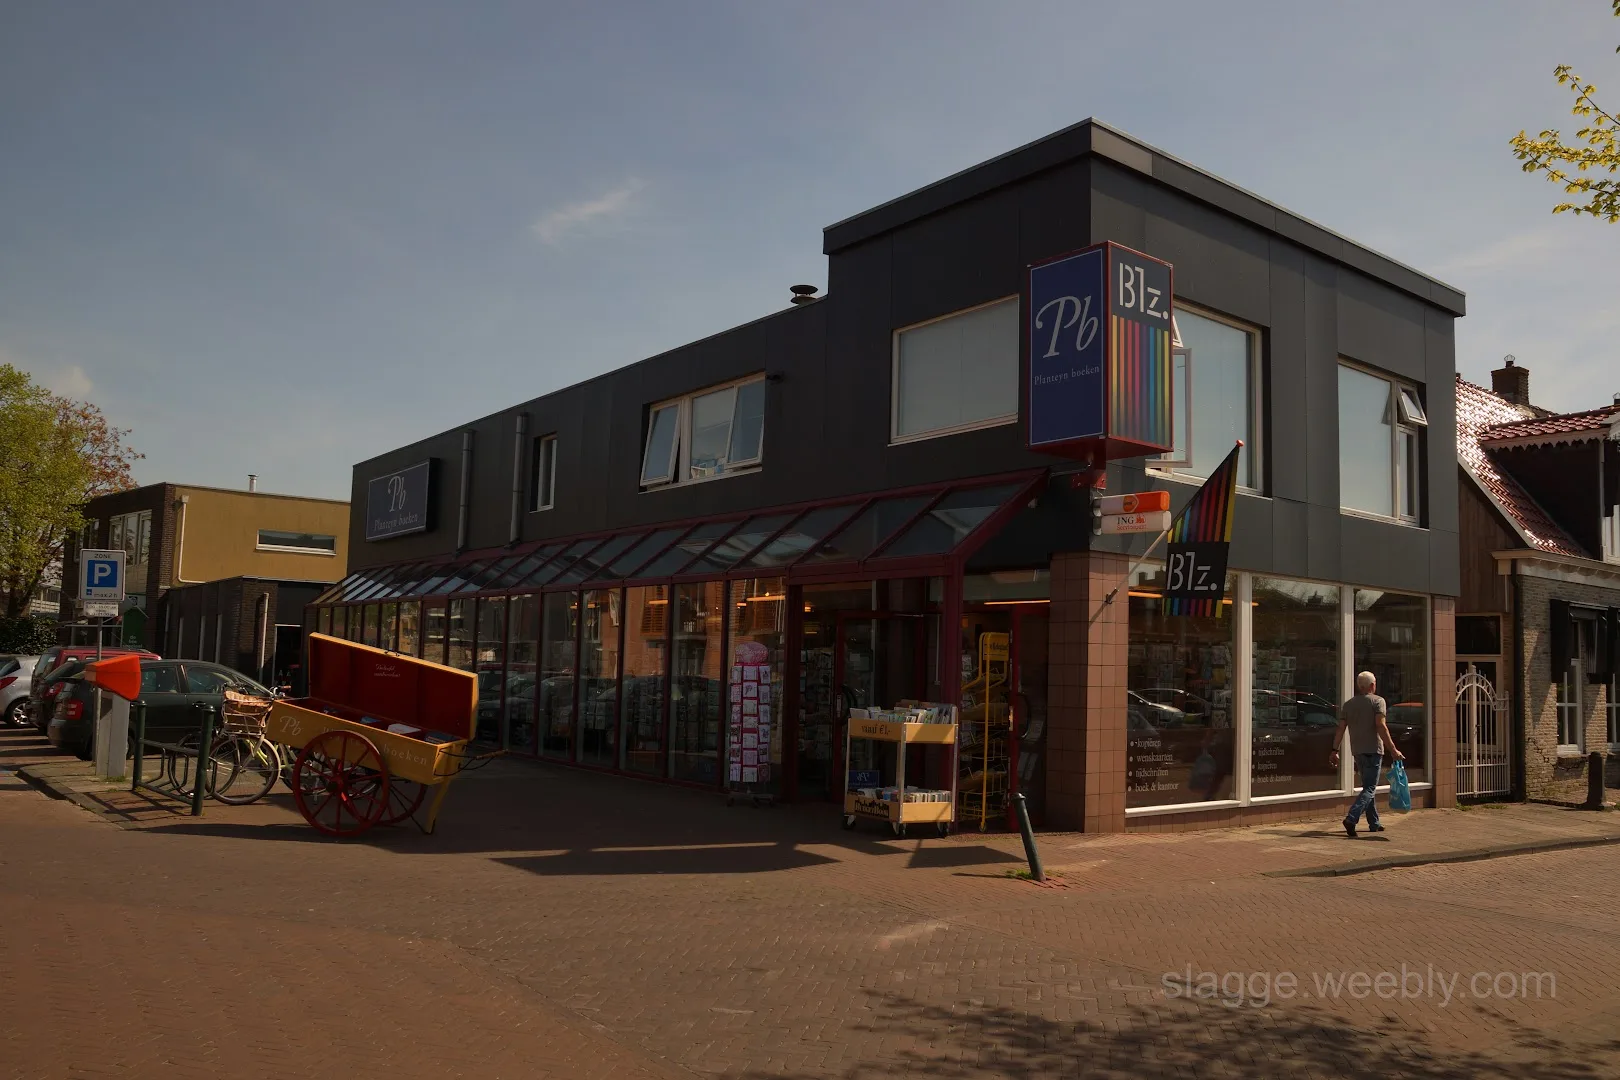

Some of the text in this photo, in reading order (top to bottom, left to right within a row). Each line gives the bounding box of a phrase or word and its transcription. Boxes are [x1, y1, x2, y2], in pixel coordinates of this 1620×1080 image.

[1035, 295, 1099, 358] Pb
[1034, 365, 1100, 385] Planteyn boeken
[388, 476, 406, 512] Pb
[1117, 516, 1134, 525] ING
[93, 563, 112, 585] P
[279, 715, 303, 736] Pb
[383, 743, 428, 765] boeken
[1135, 782, 1150, 792] boek
[1157, 782, 1179, 791] kantoor
